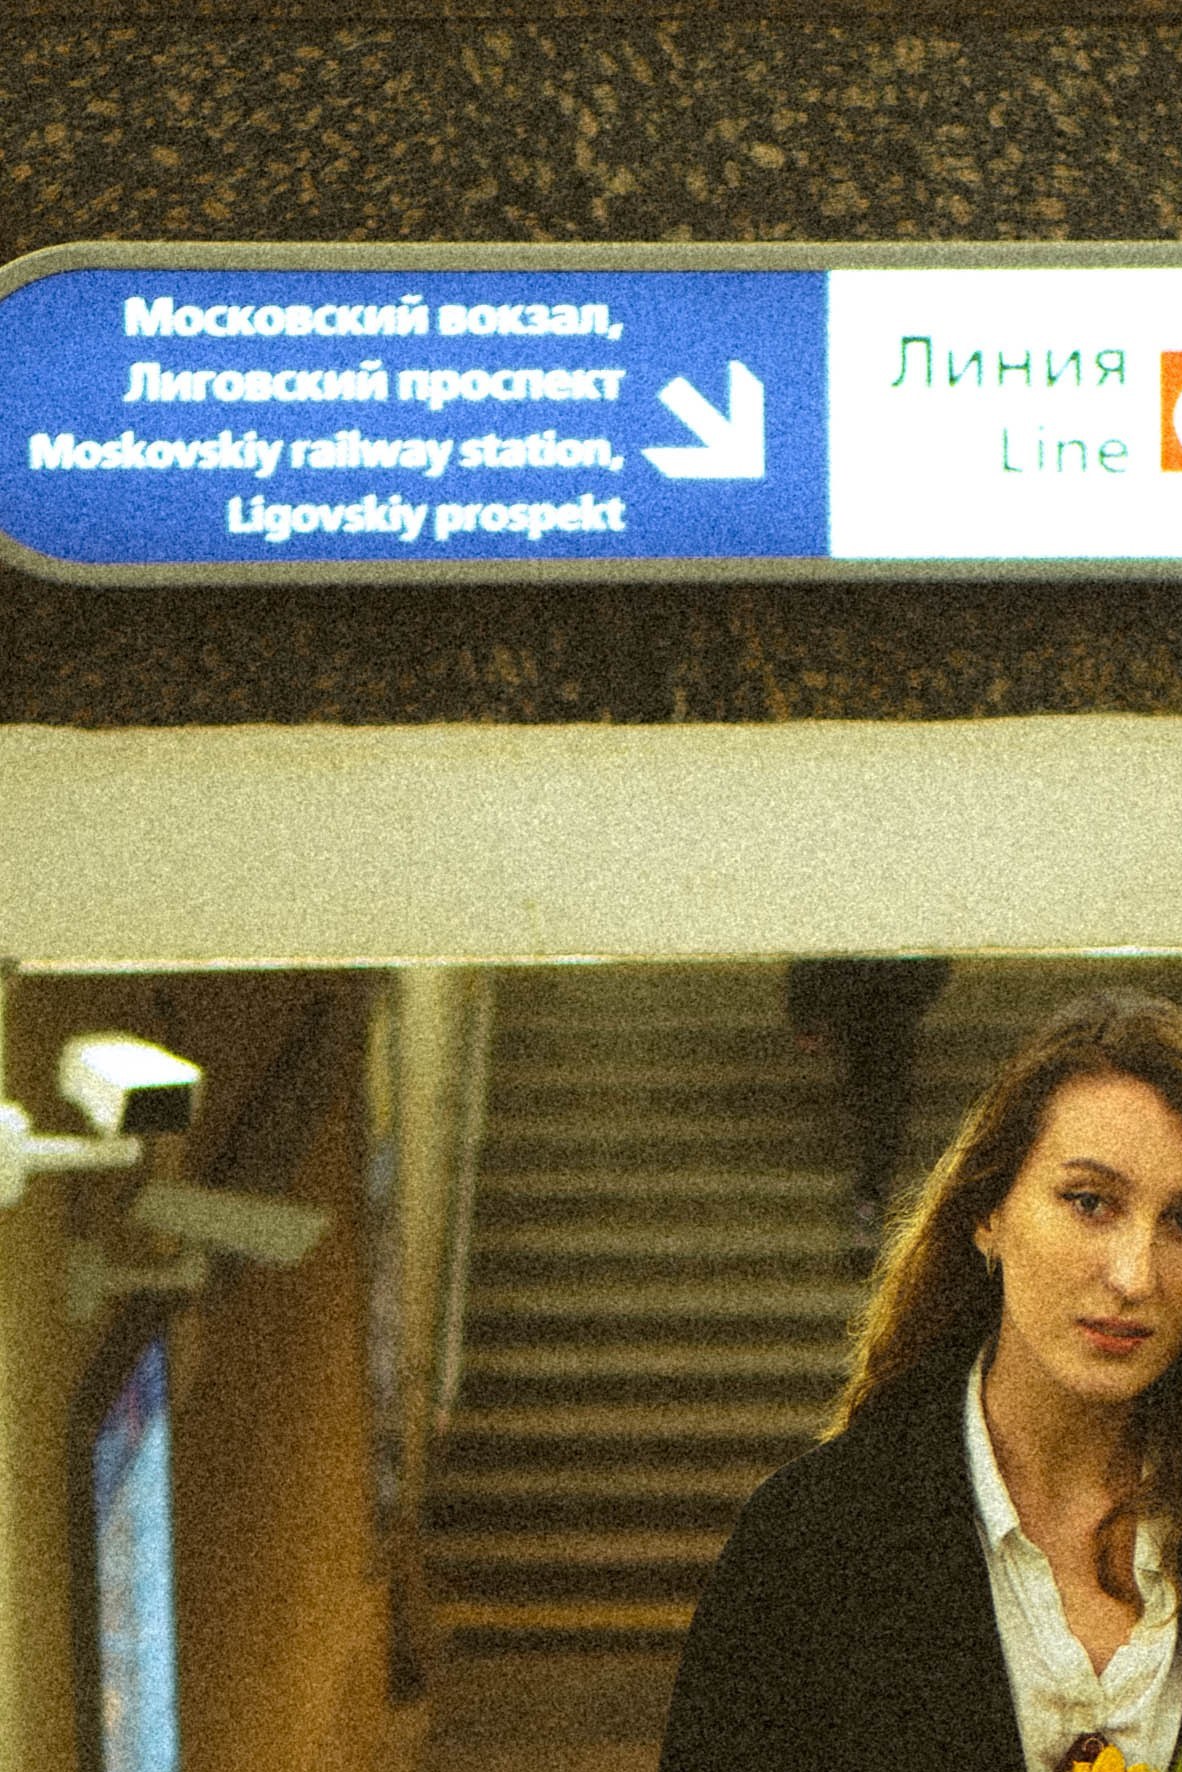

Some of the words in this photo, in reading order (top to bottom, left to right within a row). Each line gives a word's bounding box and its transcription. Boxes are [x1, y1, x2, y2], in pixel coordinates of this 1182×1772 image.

[125, 296, 429, 336] Московский
[439, 304, 624, 337] вокзал,
[124, 361, 388, 402] Лиговский
[398, 370, 625, 410] проспект
[891, 336, 1126, 388] Линия
[30, 432, 283, 478] Moskovskiy
[291, 430, 453, 477] railway
[460, 430, 624, 473] station,
[1001, 427, 1130, 475] Line
[229, 495, 427, 542] Ligovskiy
[436, 496, 625, 541] prospekt
